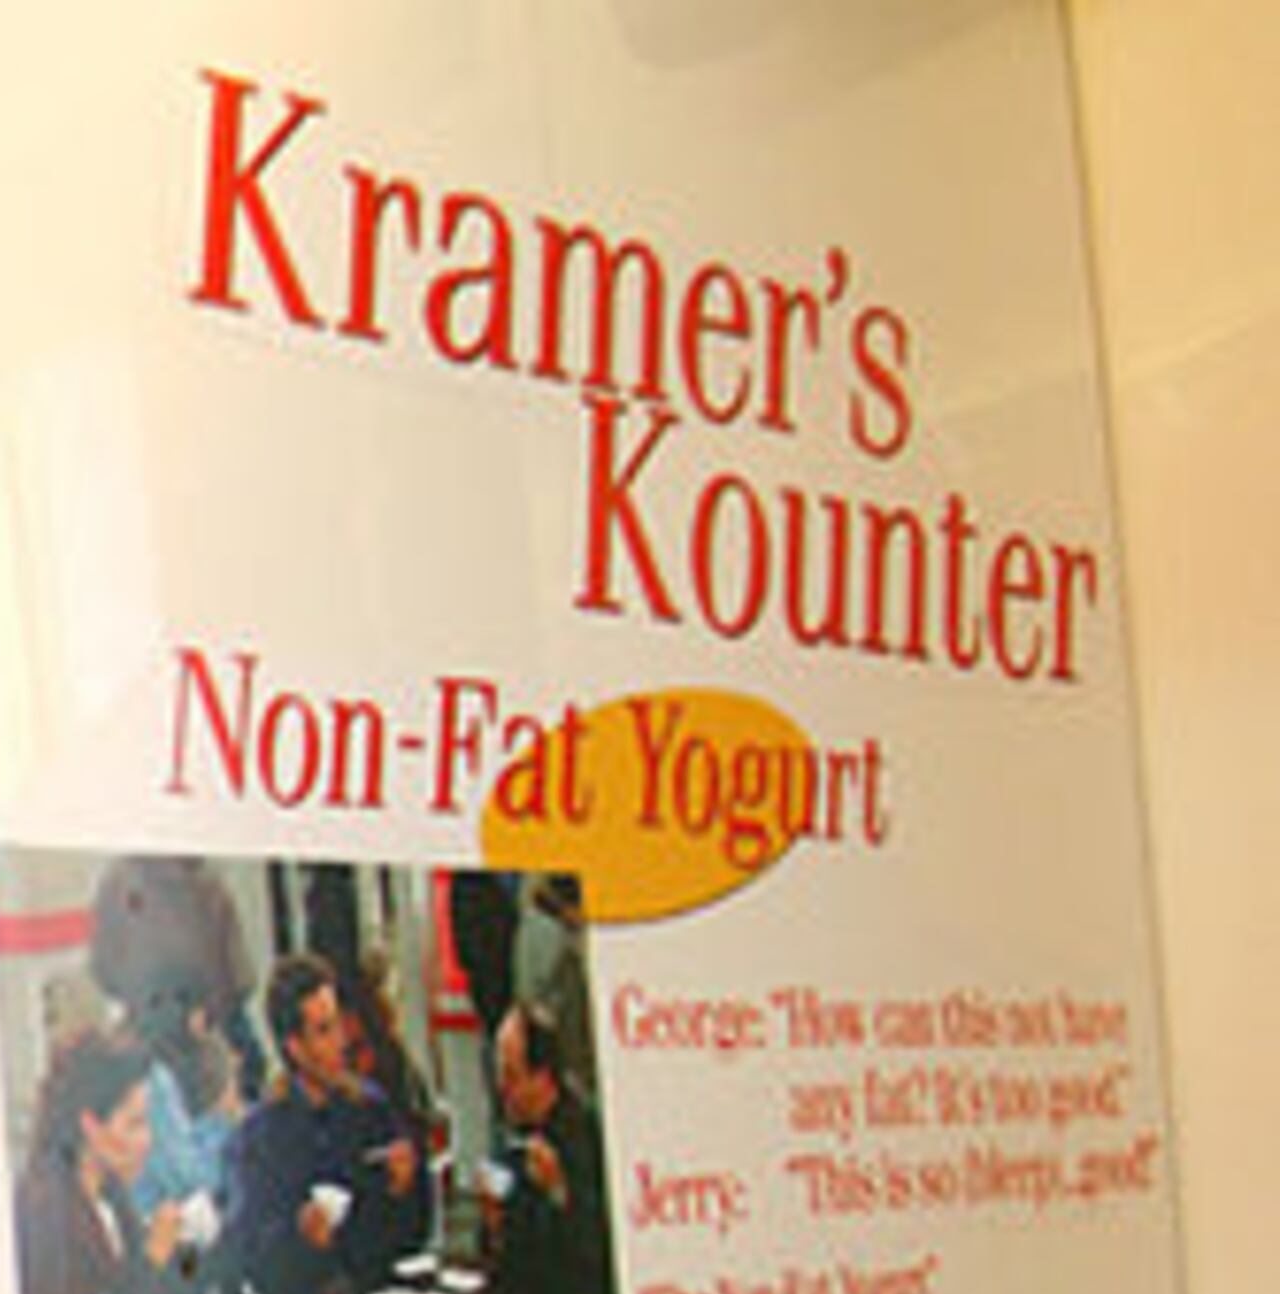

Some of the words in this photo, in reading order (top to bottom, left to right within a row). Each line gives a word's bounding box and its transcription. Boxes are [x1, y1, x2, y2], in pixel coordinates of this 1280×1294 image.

[188, 66, 912, 460] Kramer's
[573, 391, 1098, 684] Kounter
[164, 645, 597, 827] Non-Fat
[626, 696, 890, 869] Yogurt
[789, 1085, 852, 1141] any
[873, 1000, 934, 1047] can
